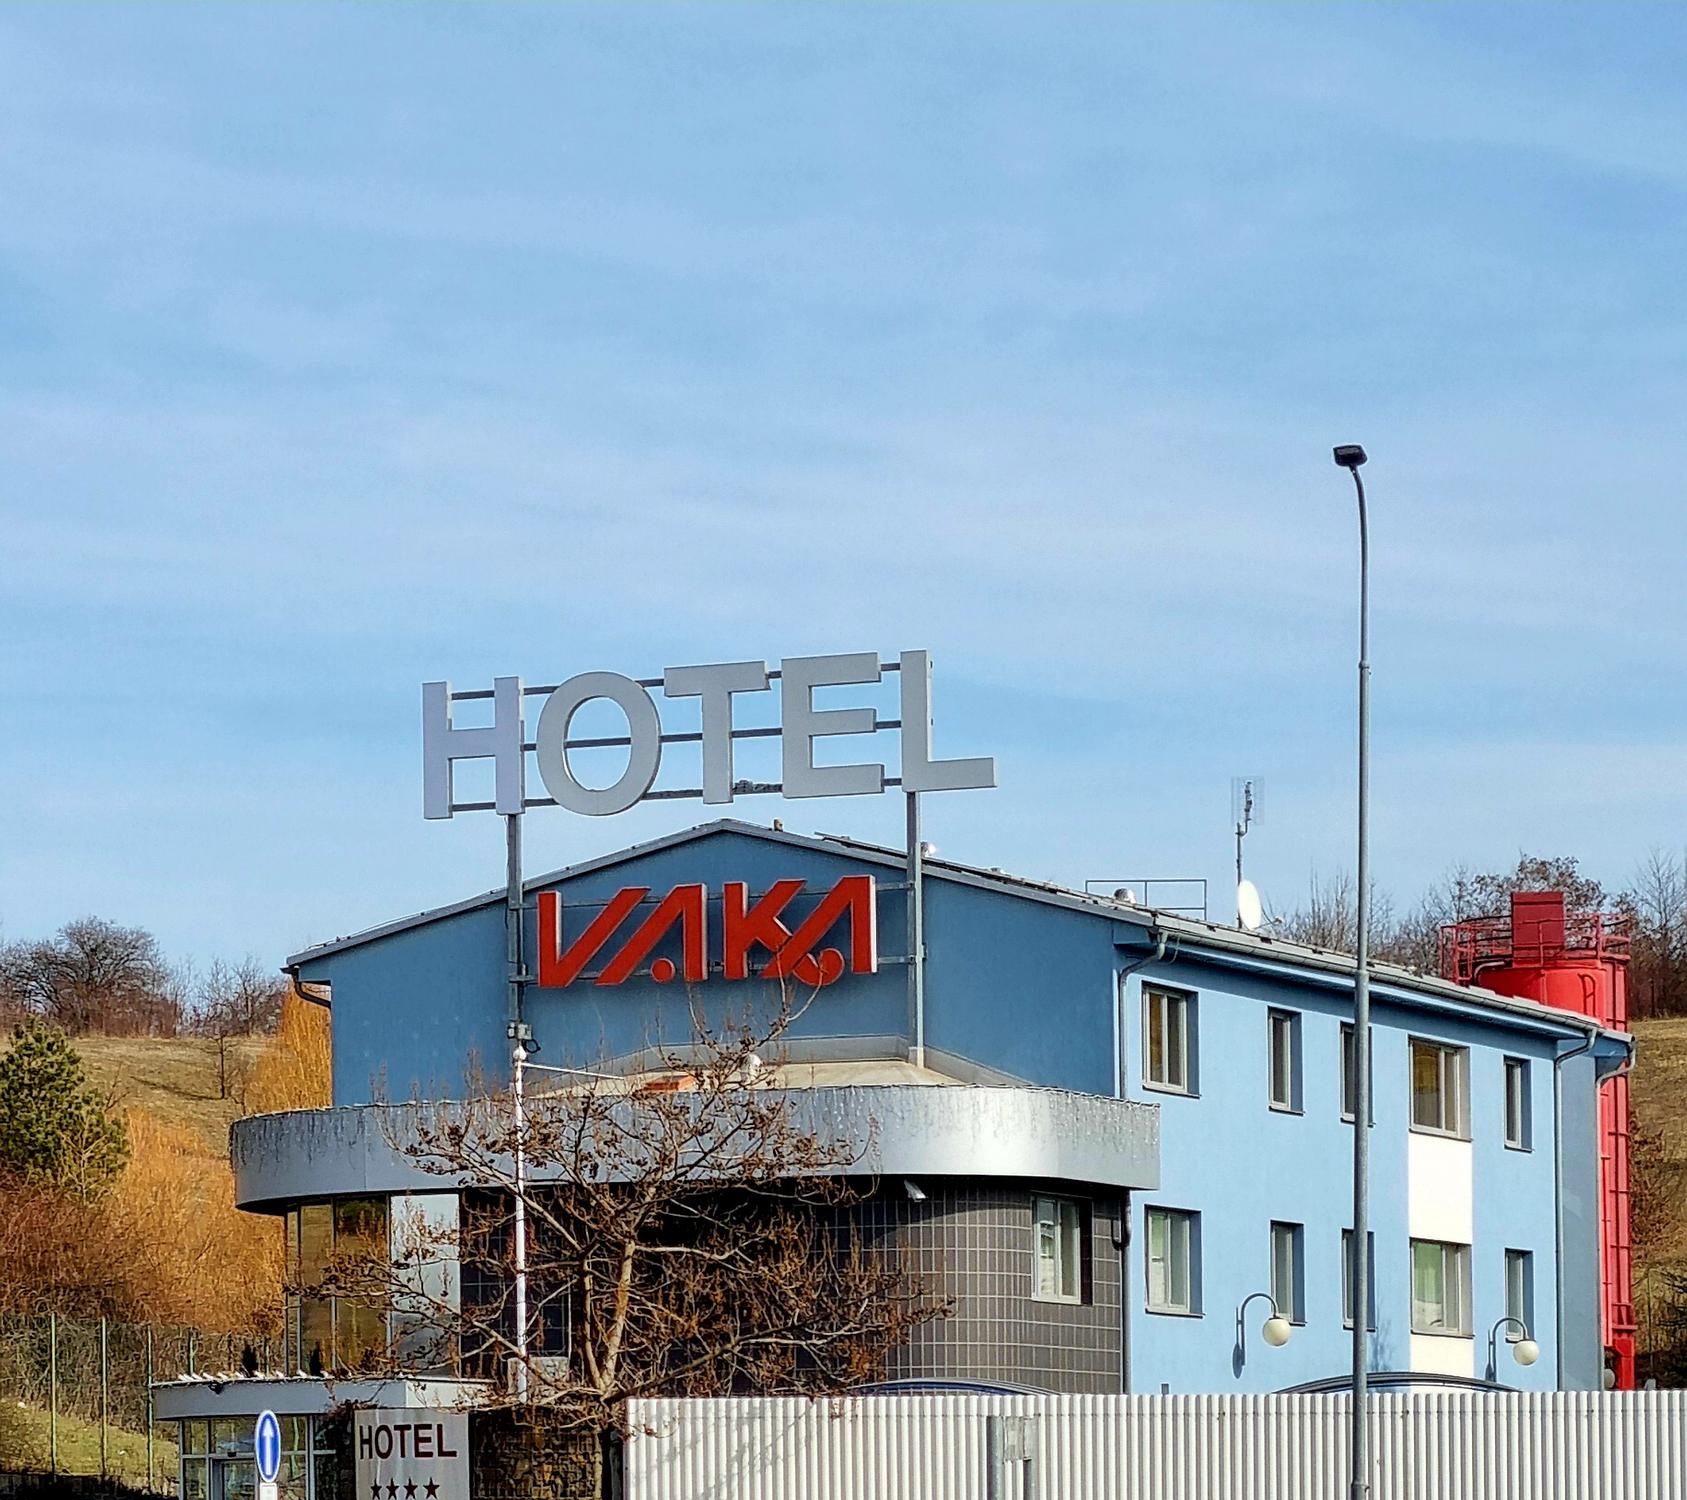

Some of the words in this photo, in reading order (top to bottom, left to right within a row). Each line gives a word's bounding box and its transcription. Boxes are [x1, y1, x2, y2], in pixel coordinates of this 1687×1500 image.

[422, 650, 997, 819] HOTEL
[537, 875, 878, 988] VAKA
[359, 1423, 457, 1460] HOTEL
